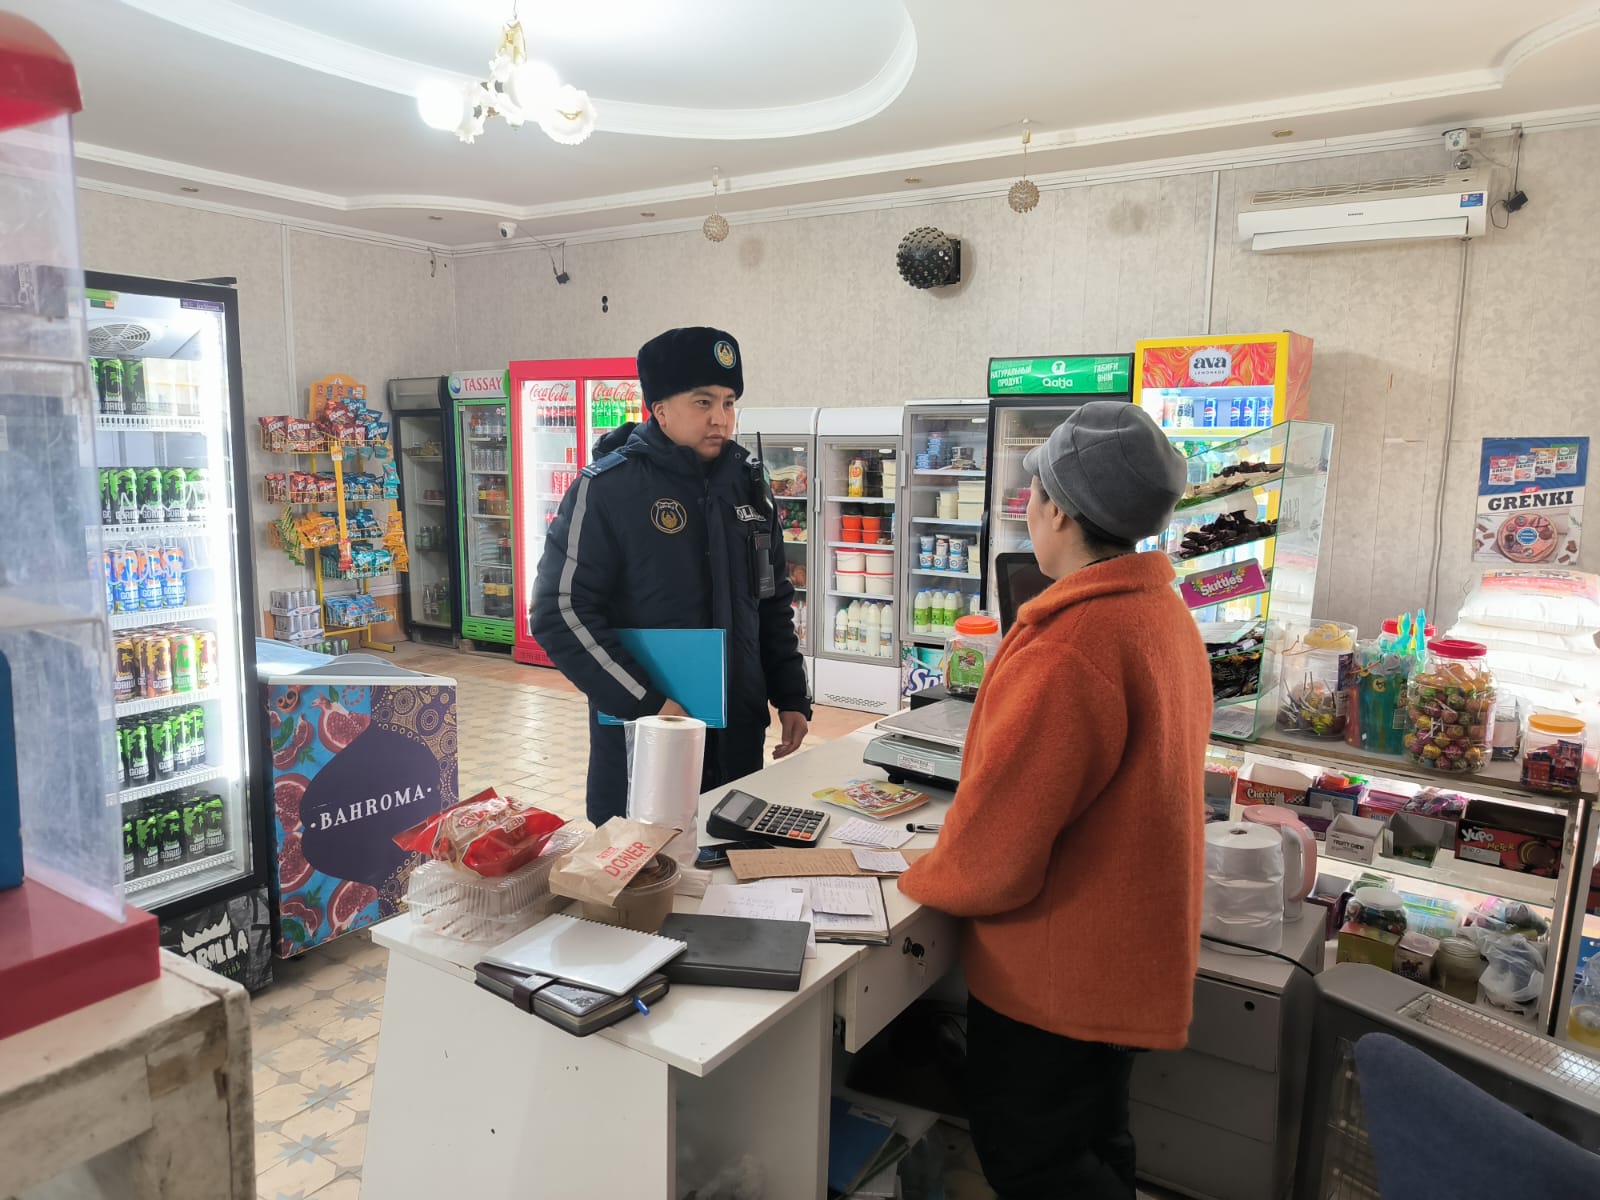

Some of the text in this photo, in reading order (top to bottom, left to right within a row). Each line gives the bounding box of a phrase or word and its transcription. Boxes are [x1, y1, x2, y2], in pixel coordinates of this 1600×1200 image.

[1193, 357, 1227, 369] ava
[463, 376, 503, 392] TASSAY
[997, 376, 1024, 388] ПРОДУКТ
[1488, 491, 1574, 511] GRENKI
[1201, 575, 1243, 596] Skittles
[320, 784, 426, 831] BAHROMA
[604, 841, 652, 878] DONER
